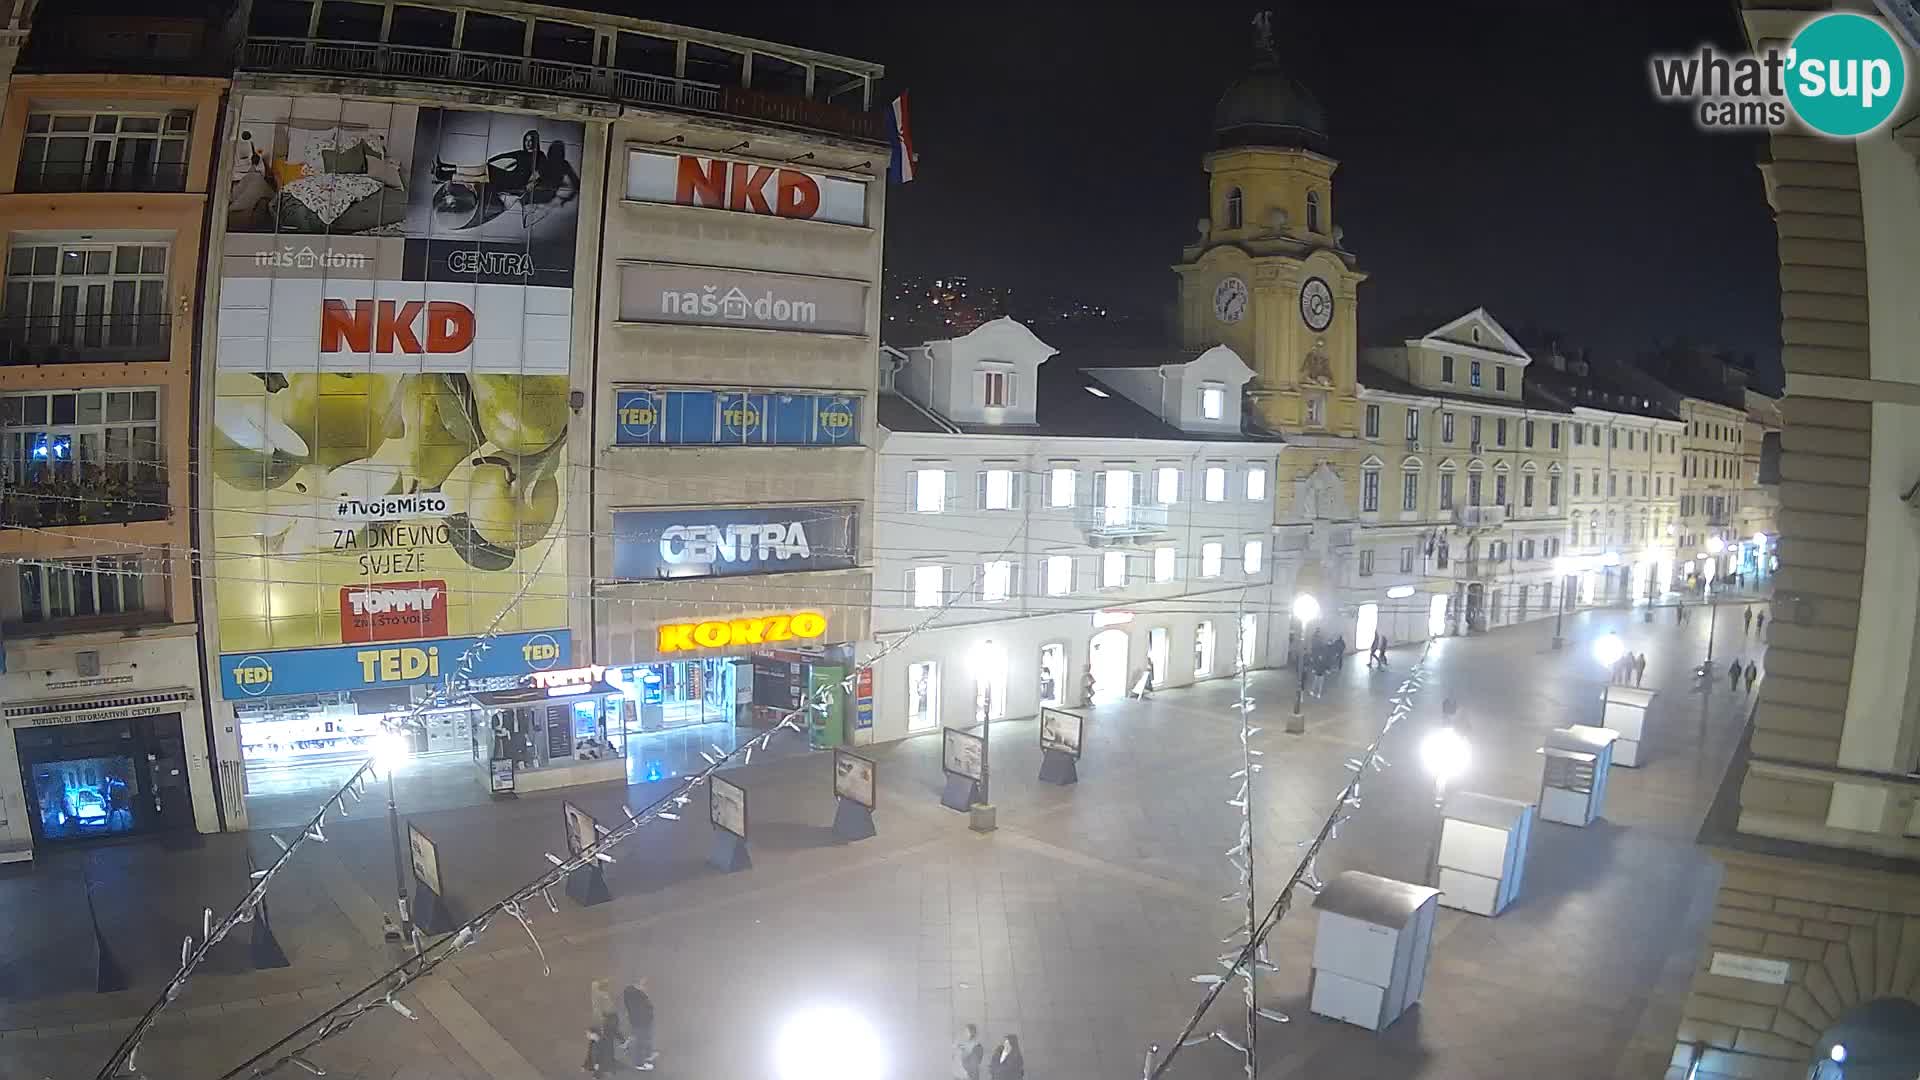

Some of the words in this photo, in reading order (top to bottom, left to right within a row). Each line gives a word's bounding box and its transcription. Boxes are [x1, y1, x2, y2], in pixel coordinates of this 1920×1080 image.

[675, 154, 821, 220] NKD
[255, 246, 293, 268] naš
[319, 248, 365, 269] dom
[448, 250, 534, 276] CENTRA
[661, 284, 718, 317] naš
[754, 290, 816, 323] dom
[320, 298, 477, 354] NKD
[619, 408, 657, 425] TEDi
[724, 410, 760, 426] TEDi
[820, 411, 853, 428] TEDi
[338, 497, 446, 517] #TvojeMisto
[333, 529, 357, 549] ZA
[367, 524, 450, 548] DNEVNO
[659, 521, 810, 564] CENTRA
[359, 547, 426, 576] SVJEŽE
[348, 587, 439, 615] TOMMY
[658, 611, 827, 653] KORZO
[522, 642, 560, 661] TEDi
[234, 666, 273, 685] TEDi
[357, 647, 440, 684] TEDi
